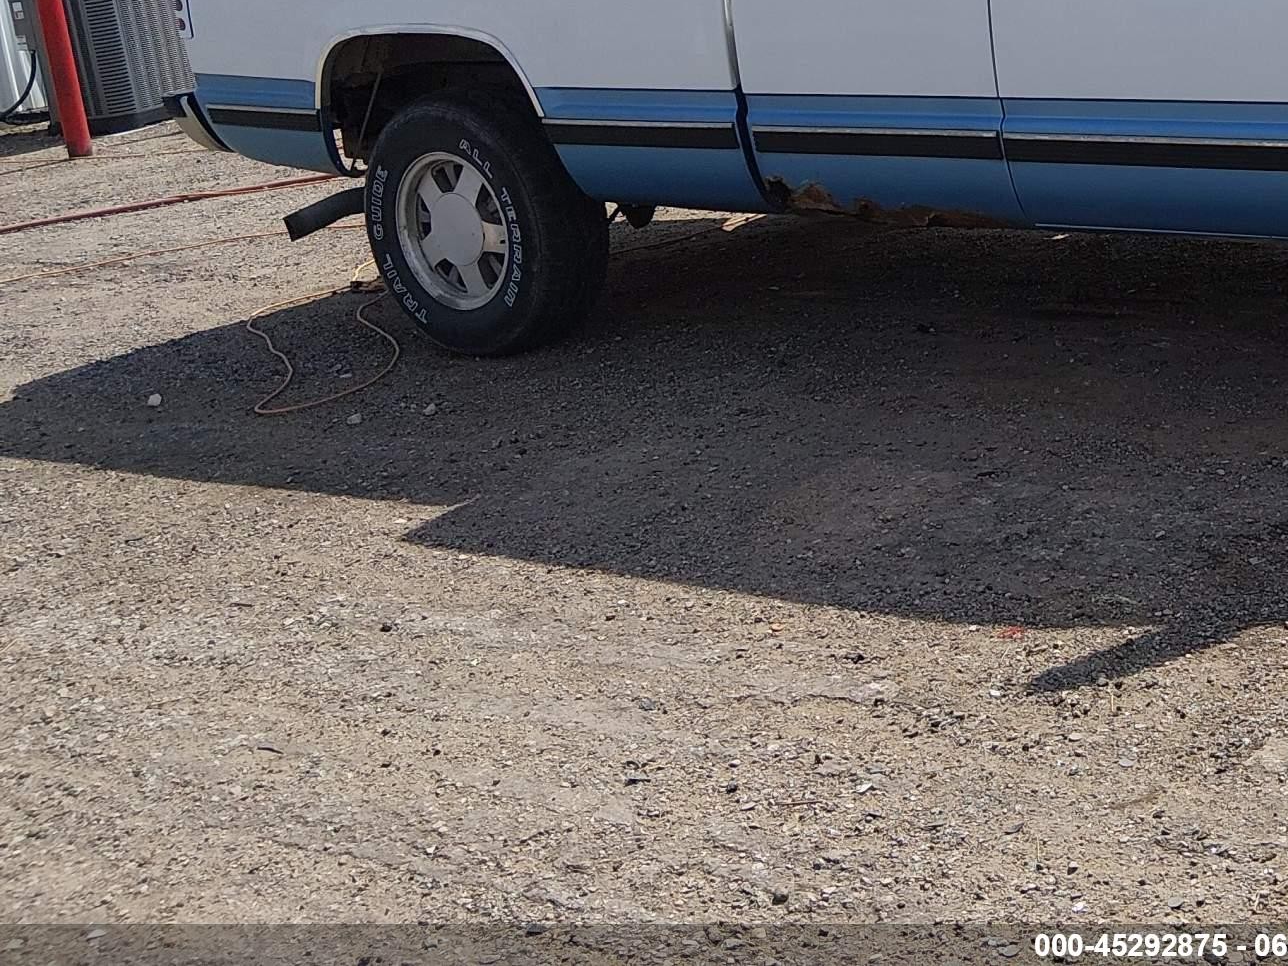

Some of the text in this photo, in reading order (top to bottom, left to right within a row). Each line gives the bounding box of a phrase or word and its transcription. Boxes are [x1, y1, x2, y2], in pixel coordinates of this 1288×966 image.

[373, 166, 429, 324] TRAIL GUIDE
[459, 139, 522, 307] ALL TERRAIN
